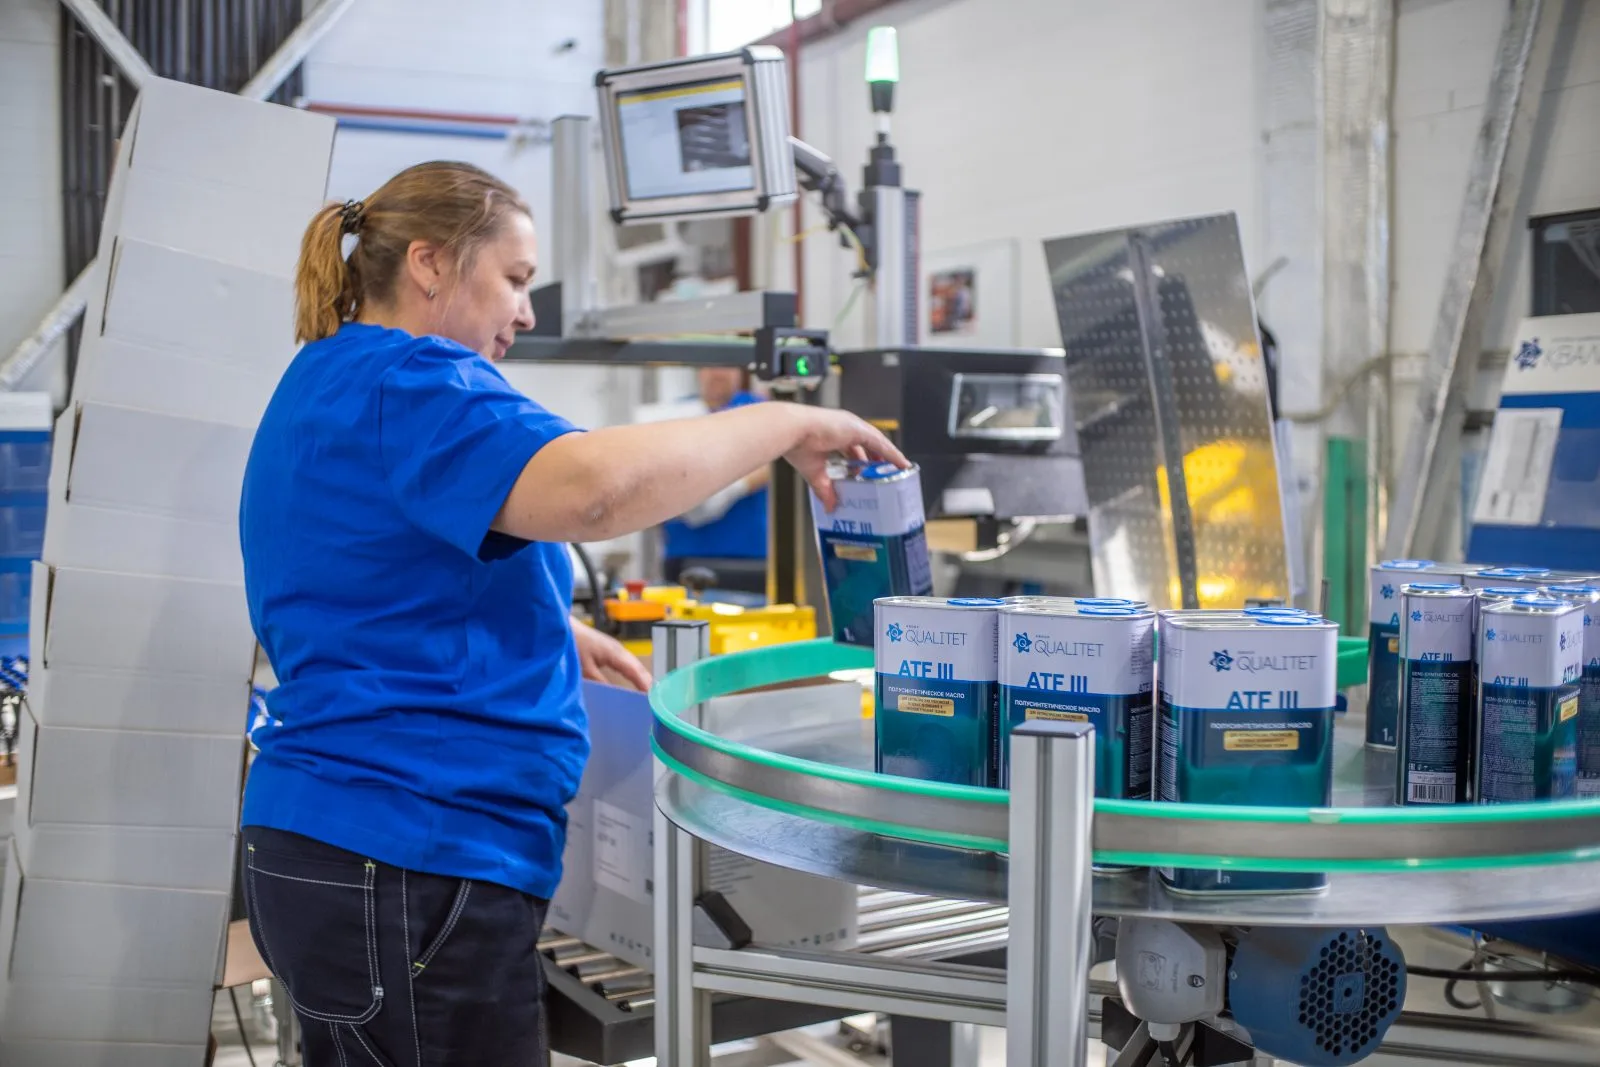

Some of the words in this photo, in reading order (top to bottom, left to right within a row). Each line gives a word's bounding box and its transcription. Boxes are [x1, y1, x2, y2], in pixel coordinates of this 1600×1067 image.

[832, 519, 856, 533] ATF
[860, 521, 873, 536] III
[905, 629, 968, 646] QUALITET
[1034, 639, 1104, 657] QUALITET
[1420, 652, 1441, 661] ATF
[1443, 652, 1453, 661] III
[899, 660, 932, 679] ATF
[937, 662, 954, 680] III
[1236, 655, 1318, 674] QUALITET
[1027, 671, 1065, 691] ATF
[1070, 675, 1088, 693] III
[1494, 675, 1516, 686] ATF
[1518, 677, 1529, 687] III
[1226, 691, 1272, 709] ATF
[1279, 691, 1298, 709] III
